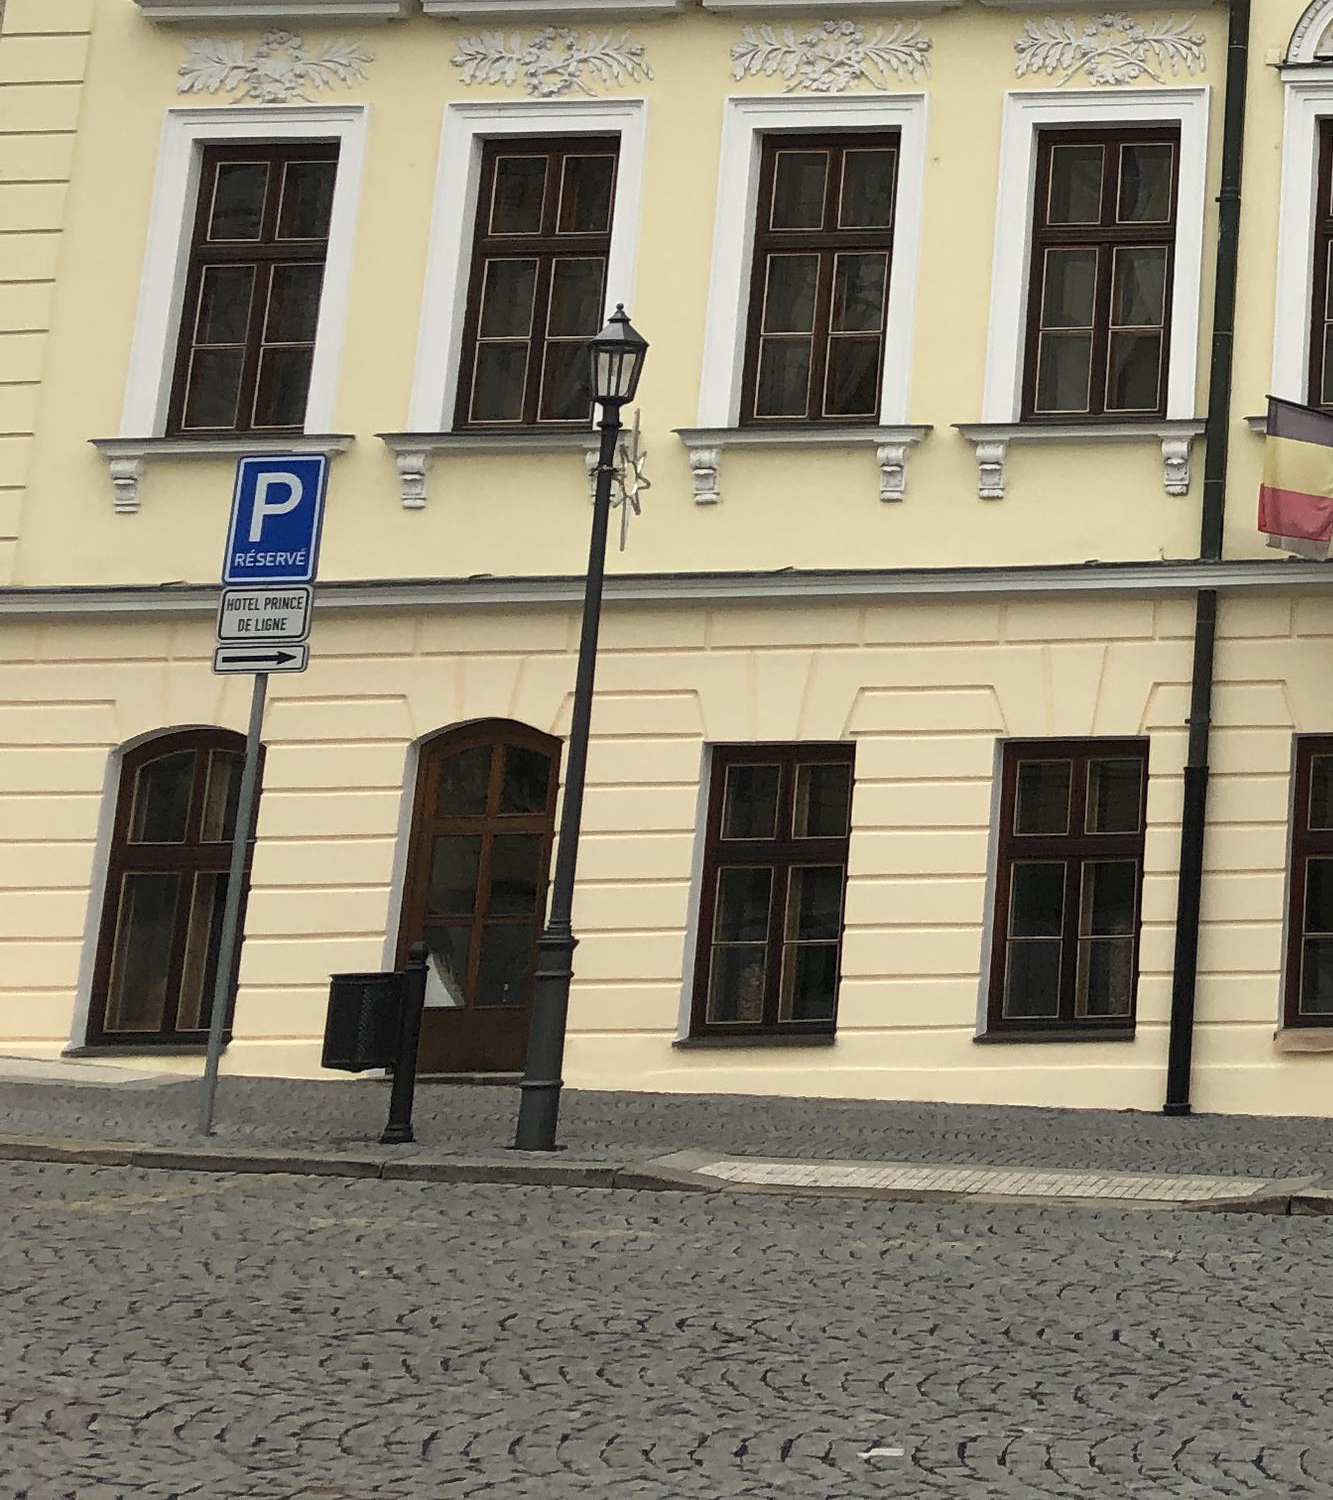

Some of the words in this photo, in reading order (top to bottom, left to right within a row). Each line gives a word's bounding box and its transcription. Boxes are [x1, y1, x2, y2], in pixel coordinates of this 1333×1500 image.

[249, 472, 304, 542] P
[235, 548, 307, 567] RÉSERVÉ
[226, 597, 260, 611] HOTEL
[264, 596, 304, 611] PRINCE
[238, 619, 253, 632] DE
[255, 618, 288, 631] LIGNE
